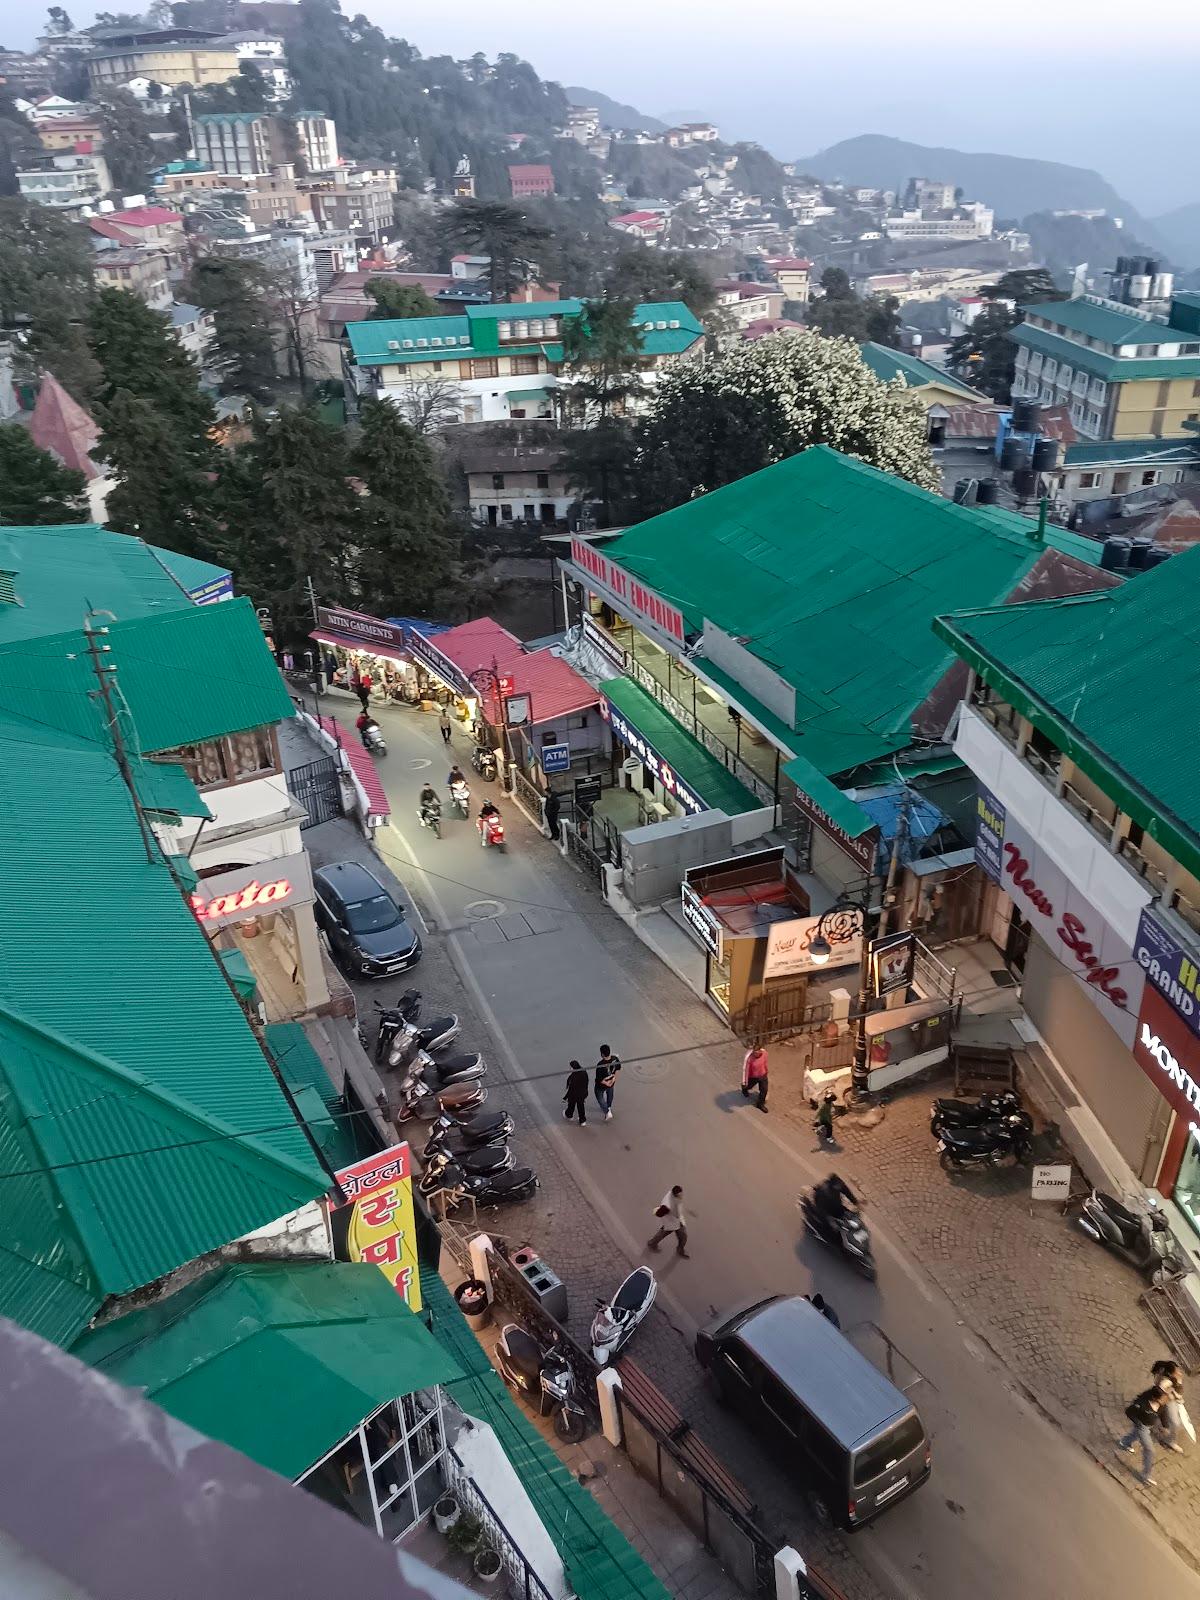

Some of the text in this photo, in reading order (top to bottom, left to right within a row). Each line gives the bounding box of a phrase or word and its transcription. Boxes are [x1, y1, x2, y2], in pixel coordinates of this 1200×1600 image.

[572, 538, 683, 641] KASHMIR ART EMPORIUM
[328, 615, 350, 627] NITIN
[350, 620, 393, 639] GARMENTS
[545, 750, 567, 761] ATM
[977, 797, 1004, 839] Hotel
[1056, 912, 1128, 1008] Style
[1138, 946, 1194, 1016] GRAND
